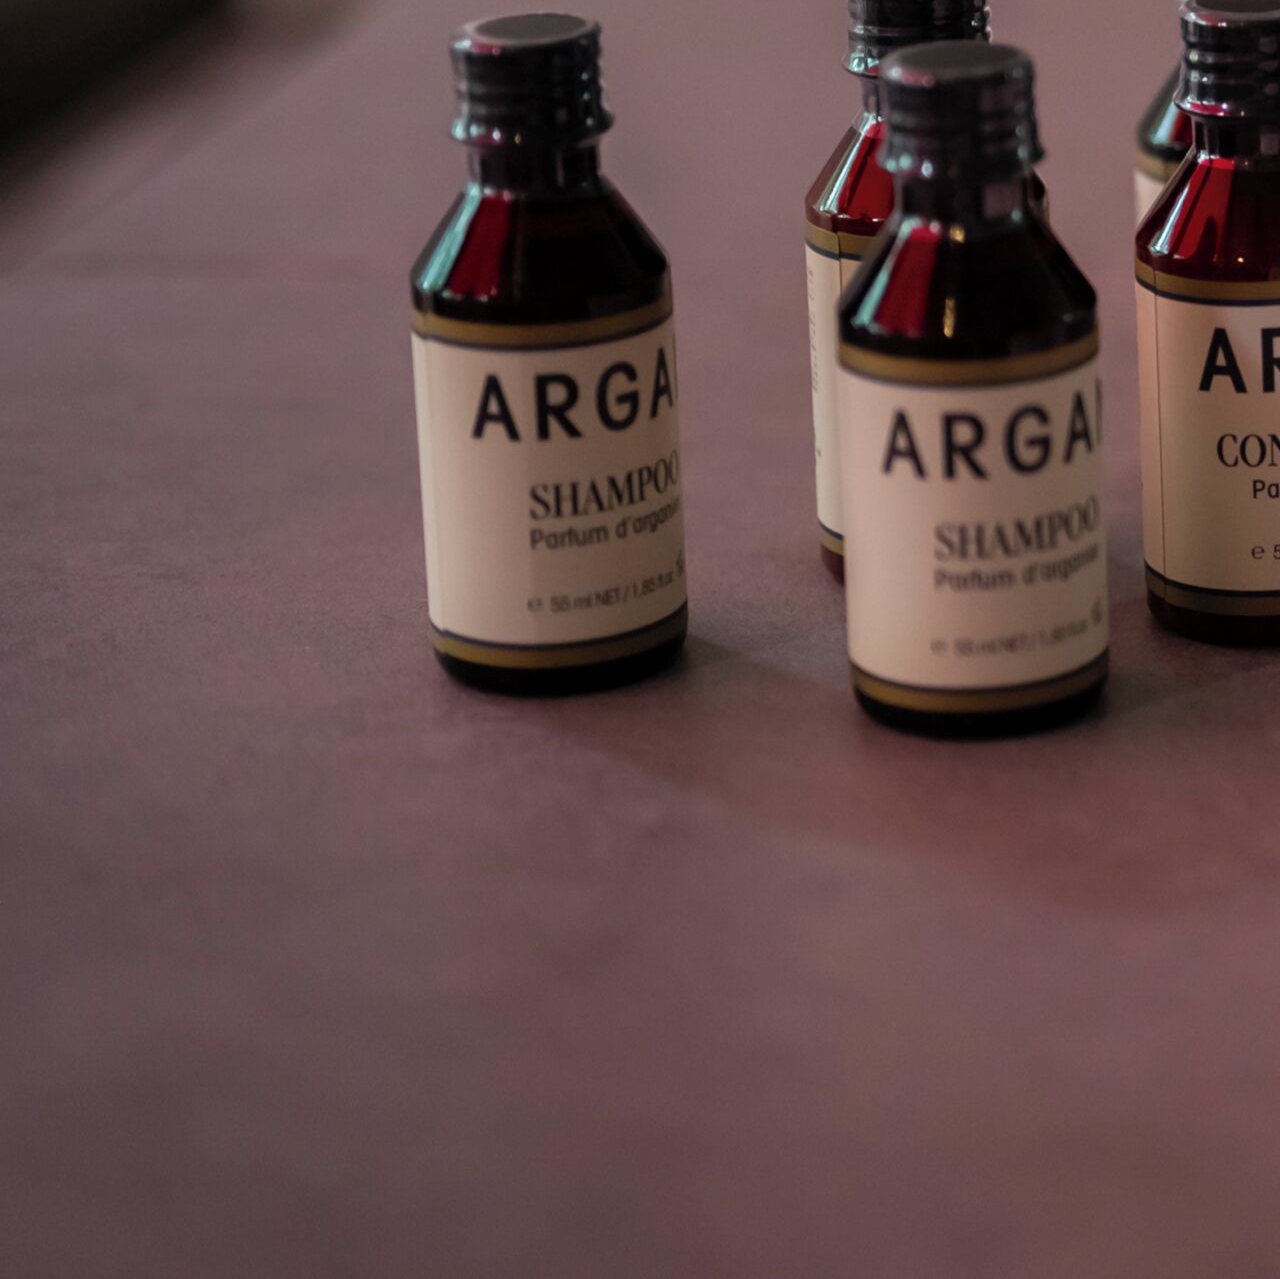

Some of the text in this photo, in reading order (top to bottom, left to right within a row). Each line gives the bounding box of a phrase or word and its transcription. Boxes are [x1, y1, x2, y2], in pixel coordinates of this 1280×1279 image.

[472, 335, 676, 442] ARGA
[530, 450, 679, 520] SHAMPOO
[530, 525, 609, 550] Parfum
[934, 494, 1097, 561] SHAMPOO
